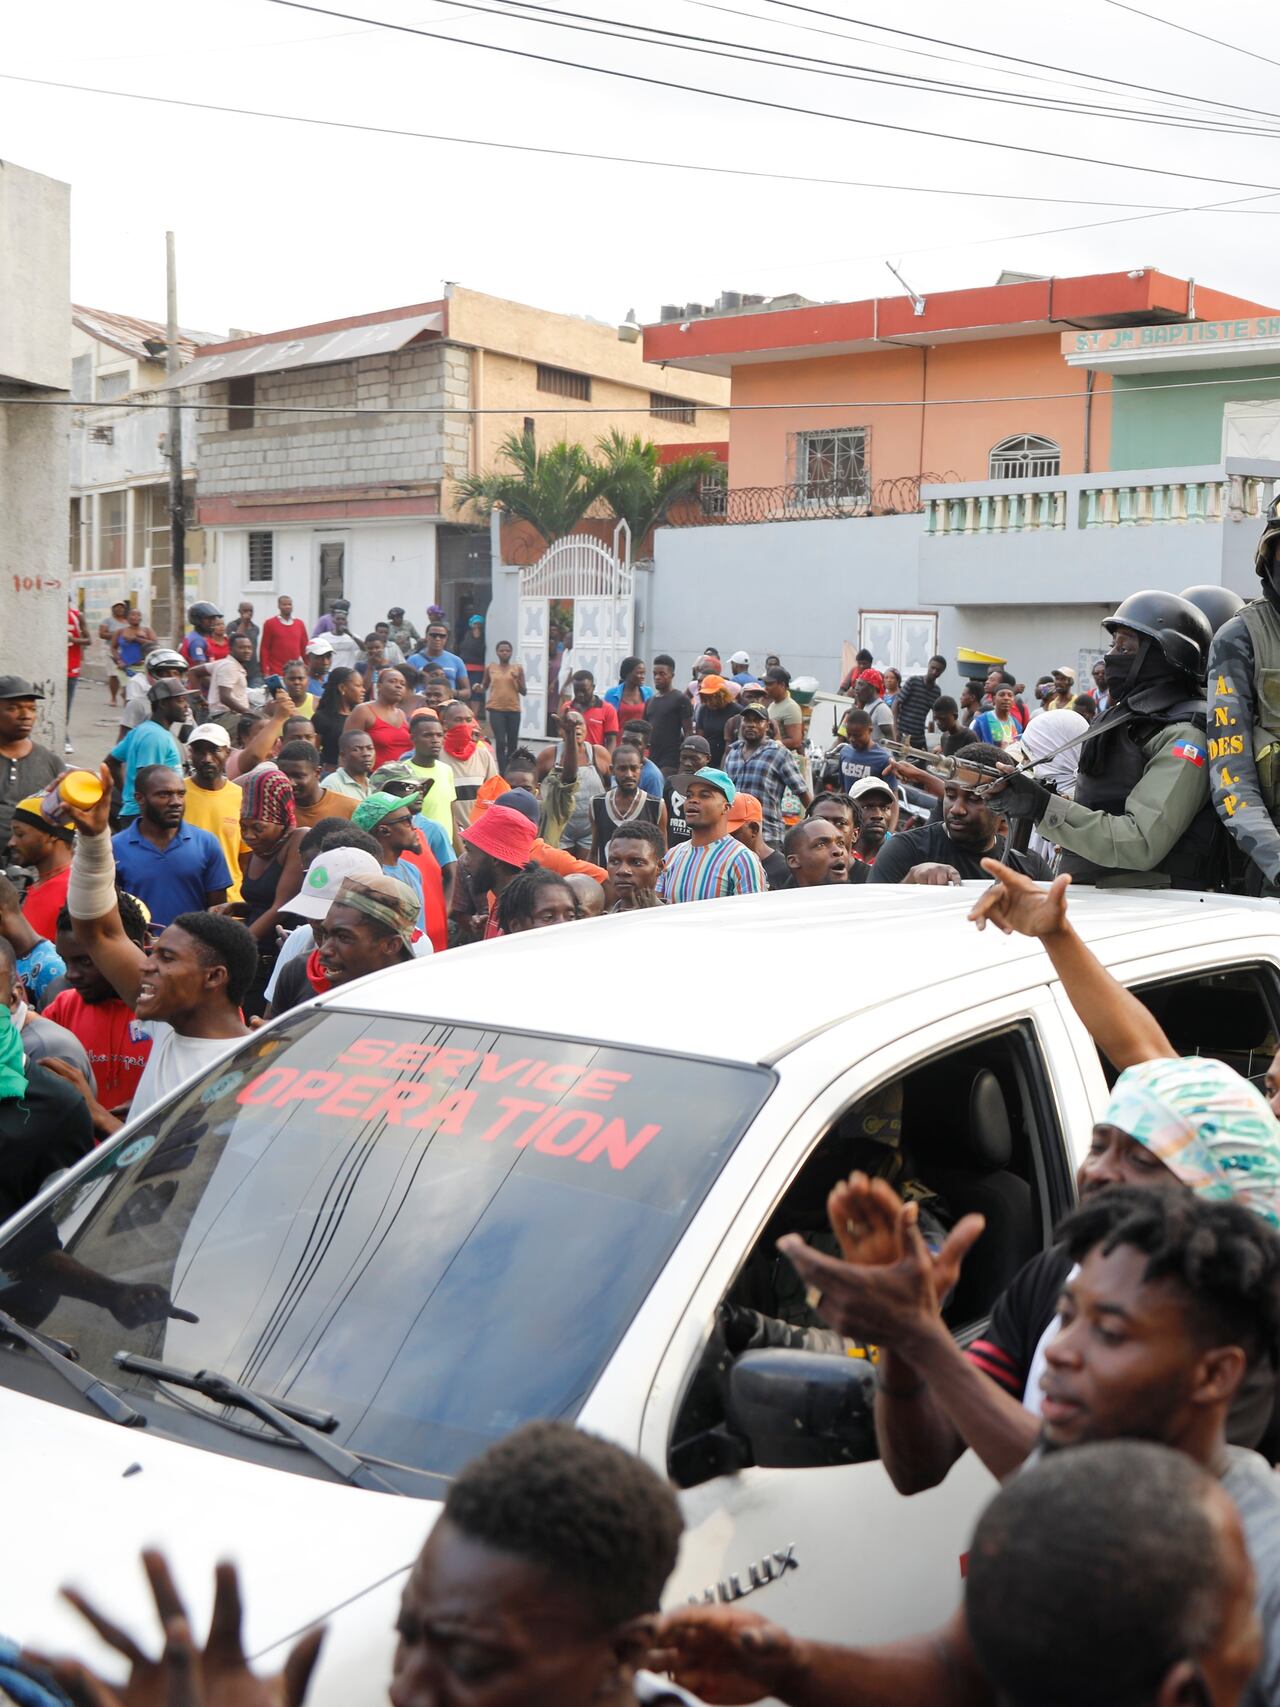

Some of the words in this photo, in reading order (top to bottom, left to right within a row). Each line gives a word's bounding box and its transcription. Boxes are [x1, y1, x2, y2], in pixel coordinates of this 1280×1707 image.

[1075, 333, 1102, 351] ST
[1139, 320, 1249, 346] BAPTISTE
[1215, 675, 1234, 696] A.
[1214, 707, 1236, 727] N.
[1208, 735, 1244, 761] DES
[1220, 767, 1240, 789] A.
[1223, 794, 1248, 816] P.
[338, 1038, 632, 1101] SERVICE
[235, 1066, 662, 1171] OPERATION
